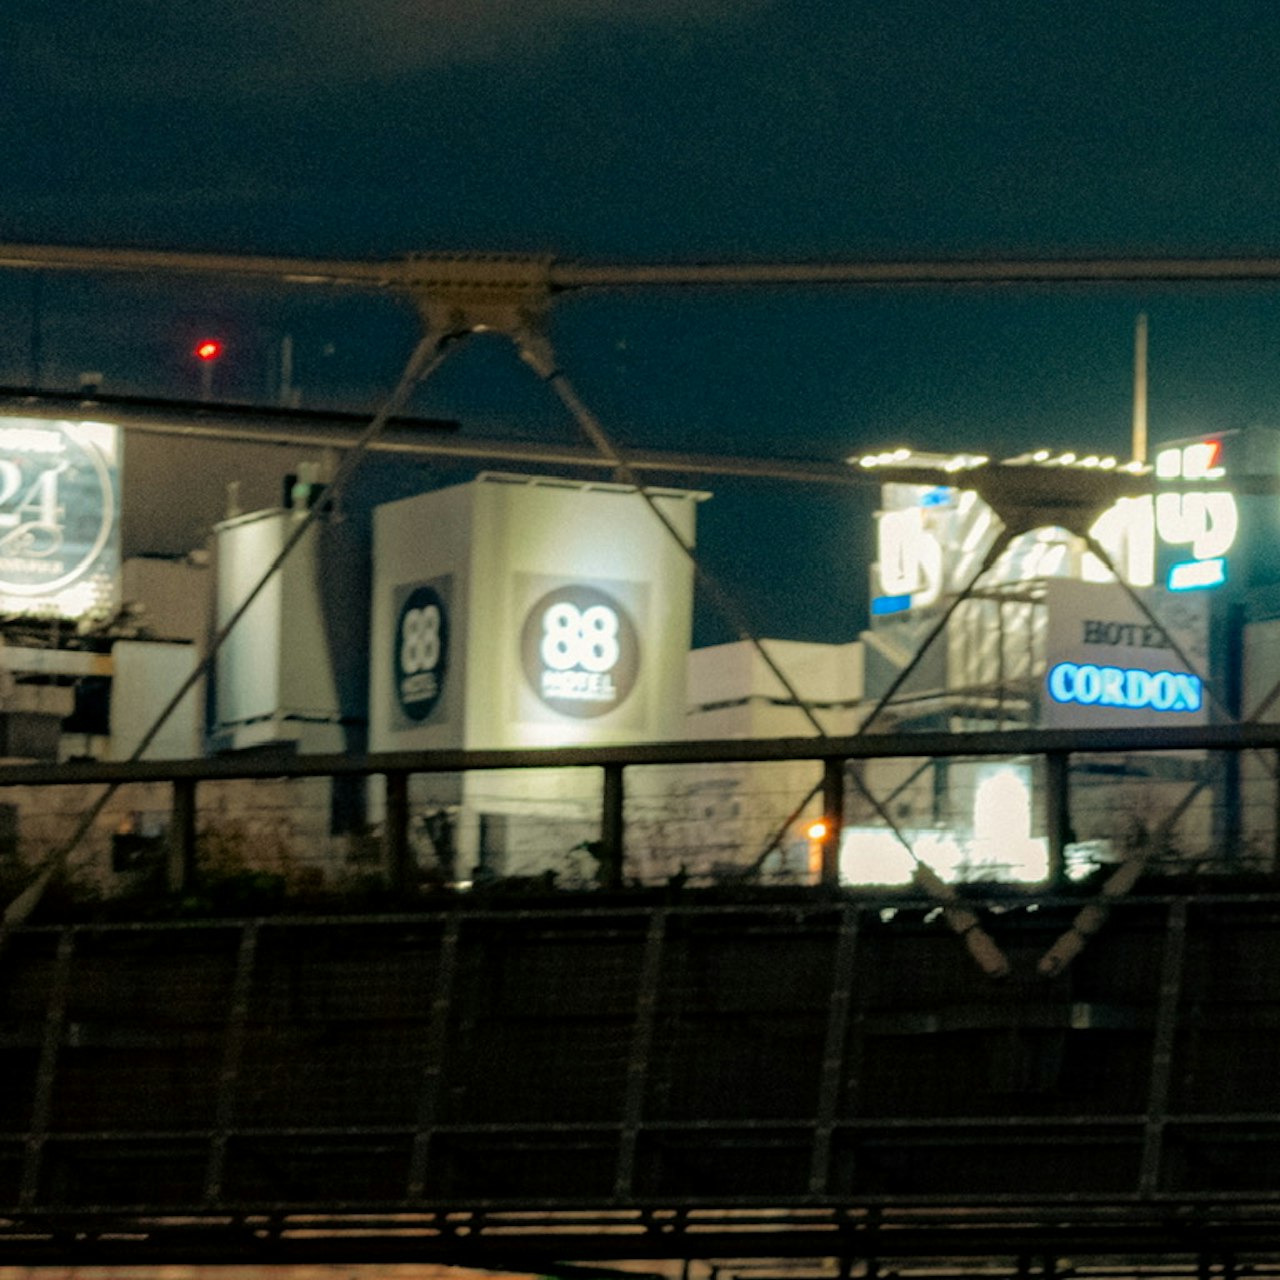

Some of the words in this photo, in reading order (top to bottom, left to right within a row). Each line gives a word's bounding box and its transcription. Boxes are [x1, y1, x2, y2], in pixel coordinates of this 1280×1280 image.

[402, 605, 440, 674] 88
[542, 601, 620, 672] 88
[1049, 662, 1203, 711] CORDON
